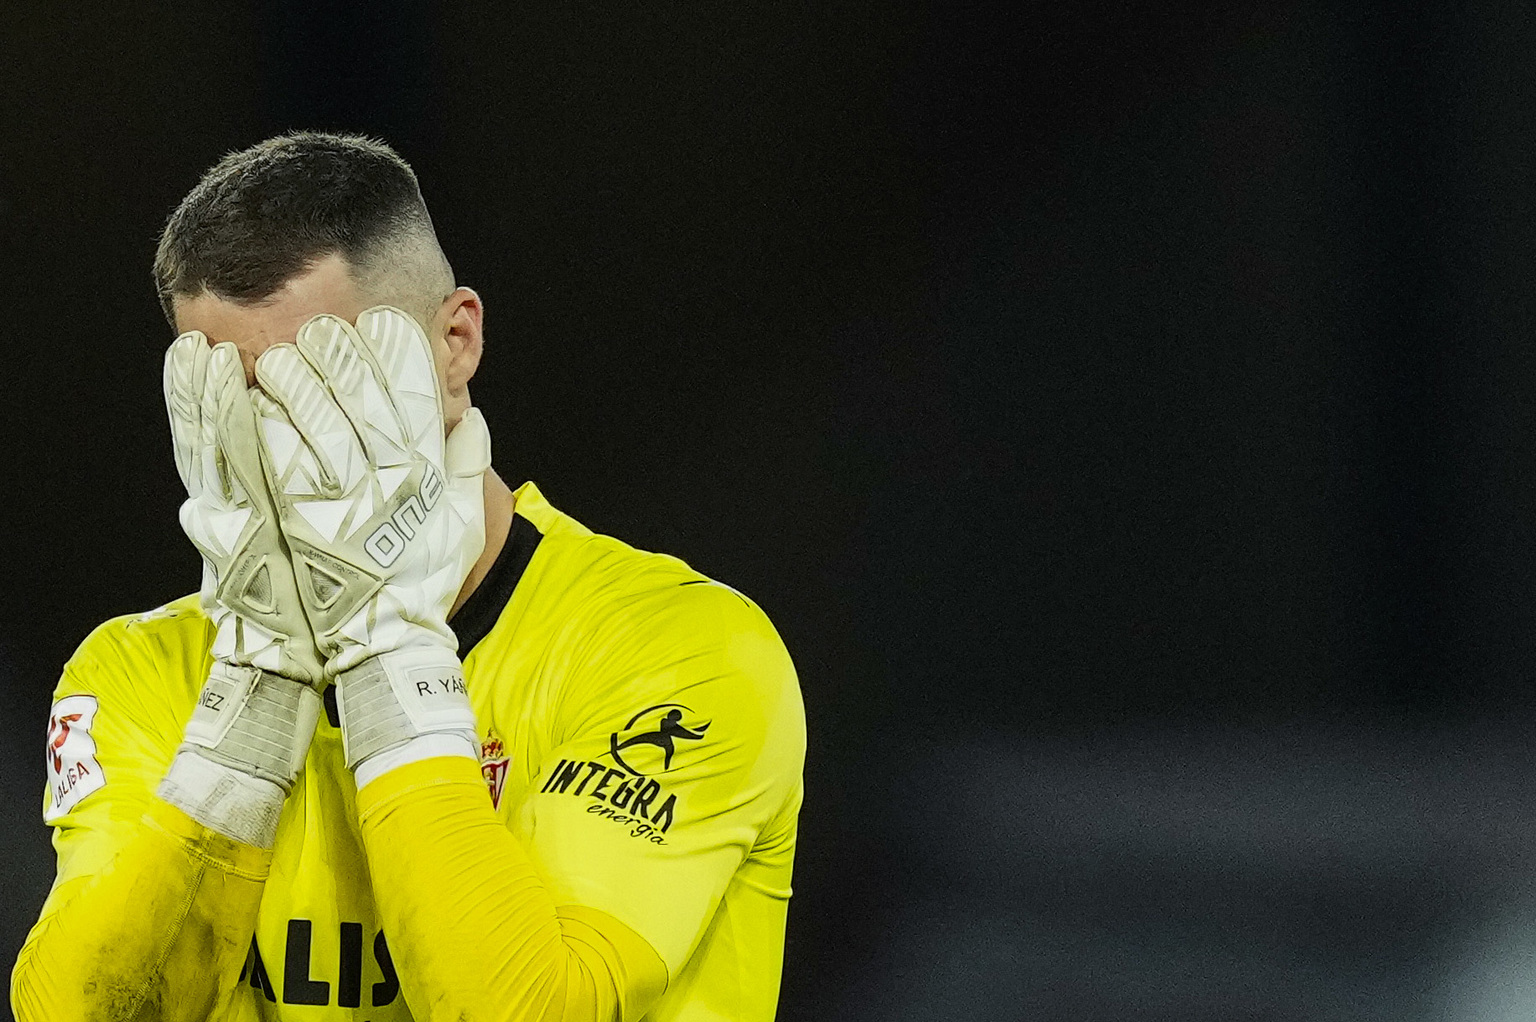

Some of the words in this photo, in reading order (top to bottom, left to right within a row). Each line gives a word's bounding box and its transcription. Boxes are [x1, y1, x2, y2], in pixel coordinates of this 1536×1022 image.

[364, 461, 444, 569] ONE
[415, 680, 438, 697] R.
[54, 761, 90, 808] LALIGA
[540, 759, 678, 835] INTEGRA
